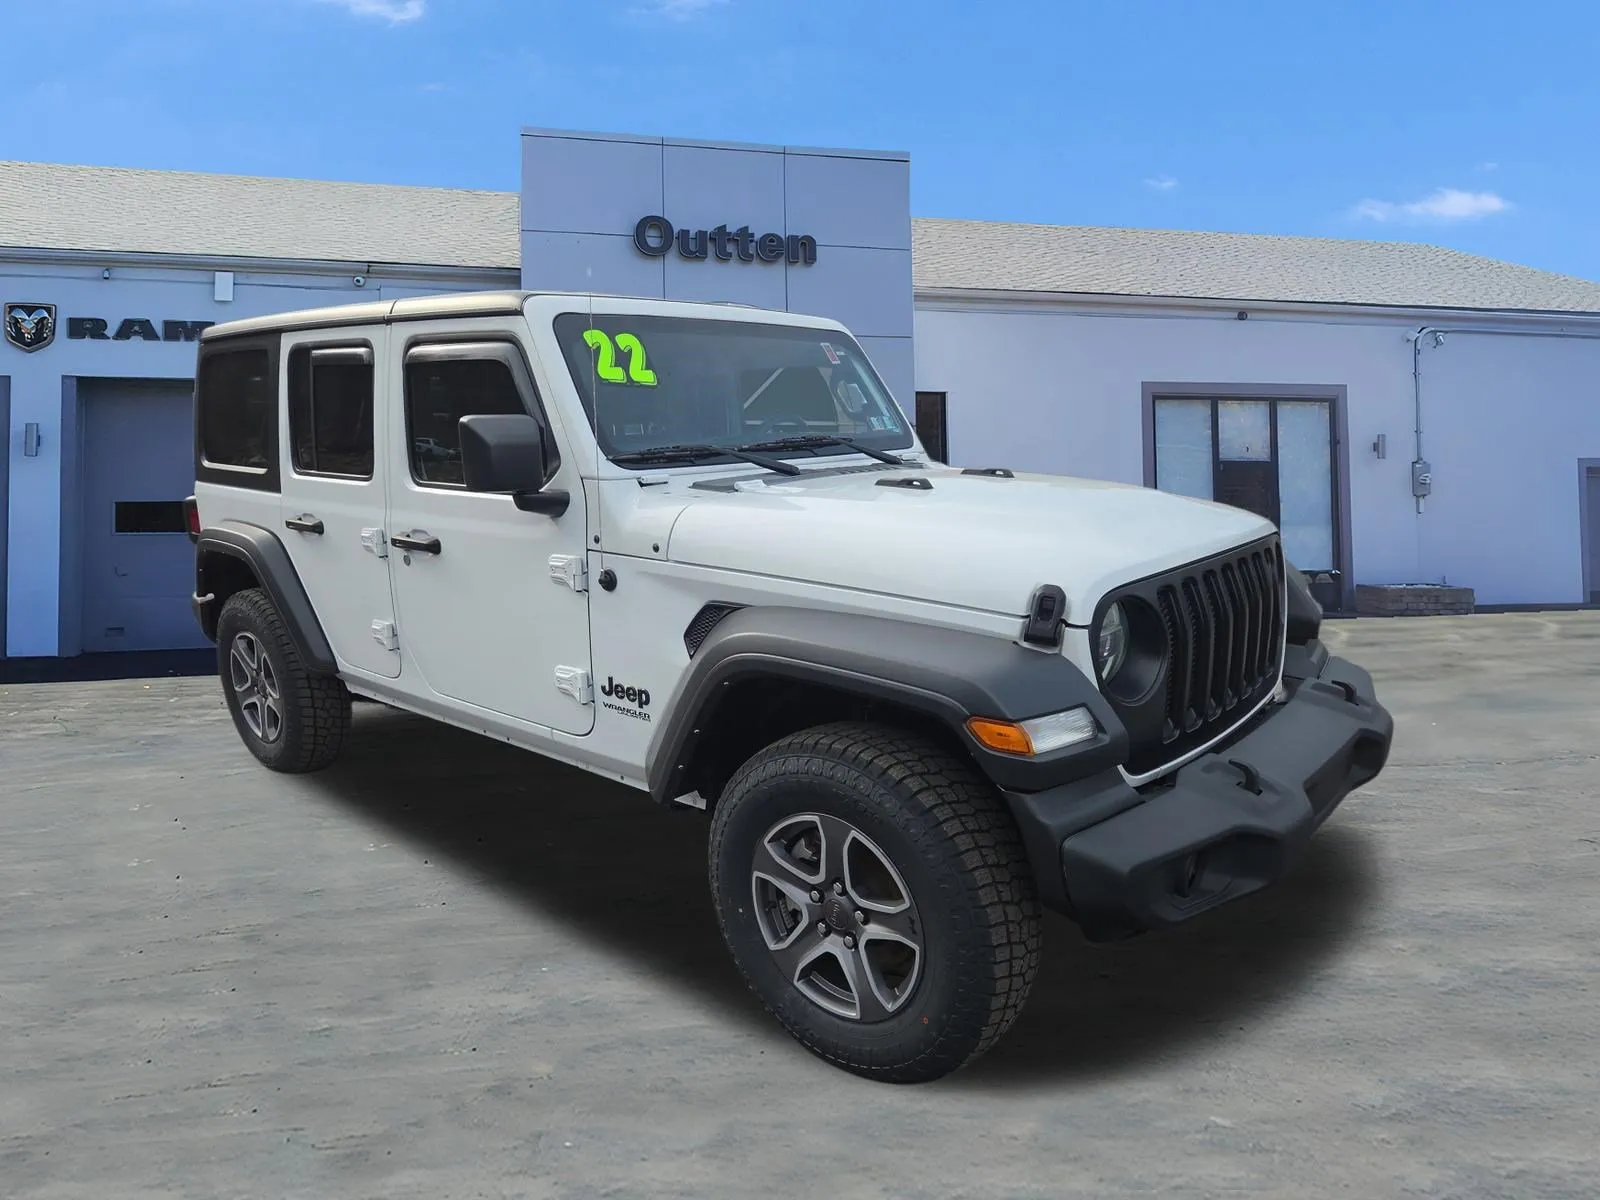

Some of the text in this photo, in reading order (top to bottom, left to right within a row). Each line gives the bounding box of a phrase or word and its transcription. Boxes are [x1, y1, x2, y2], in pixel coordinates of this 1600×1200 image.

[634, 215, 817, 264] Outten
[67, 317, 215, 342] RAM
[583, 329, 657, 386] 22
[601, 676, 650, 709] Jeep
[603, 701, 650, 719] WRANGLER
